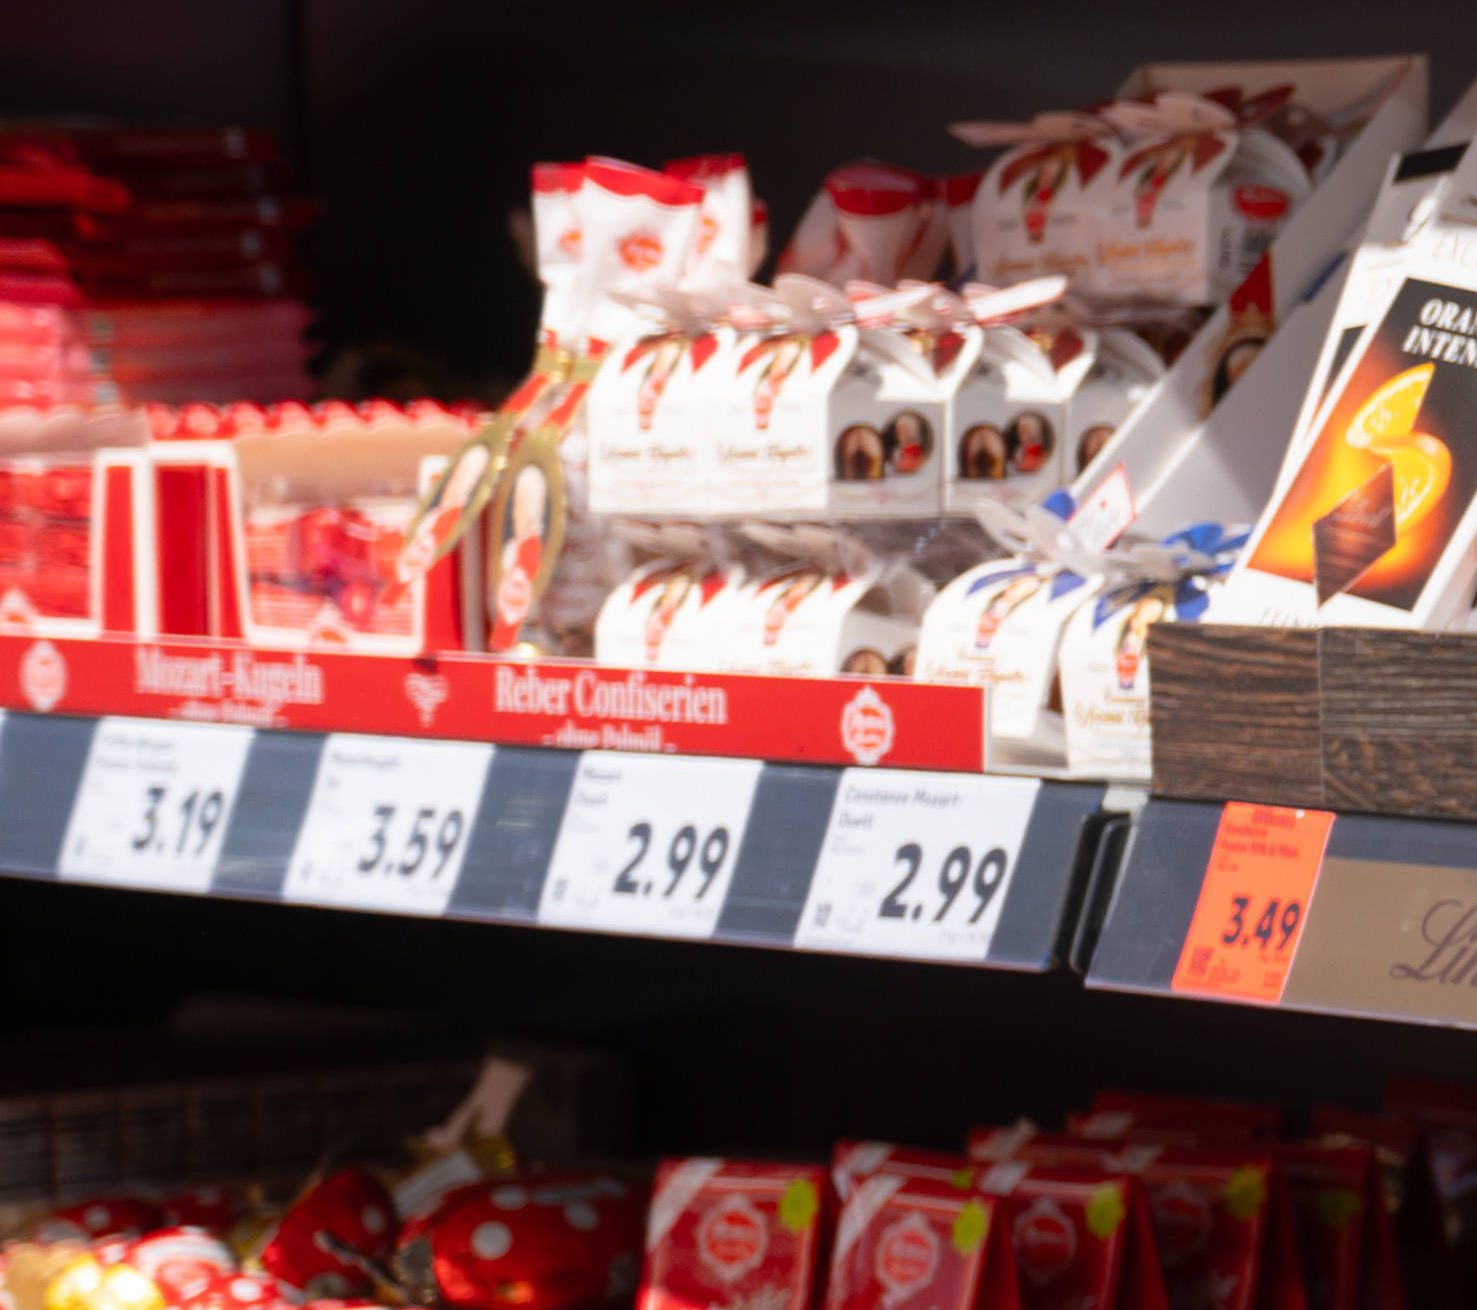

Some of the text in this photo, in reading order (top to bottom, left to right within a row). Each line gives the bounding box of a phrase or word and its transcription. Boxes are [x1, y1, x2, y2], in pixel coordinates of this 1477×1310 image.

[494, 665, 729, 725] Reber Confiserien
[357, 805, 468, 881] 3.59
[610, 822, 732, 903] 2.99
[877, 842, 1009, 926] 2.99
